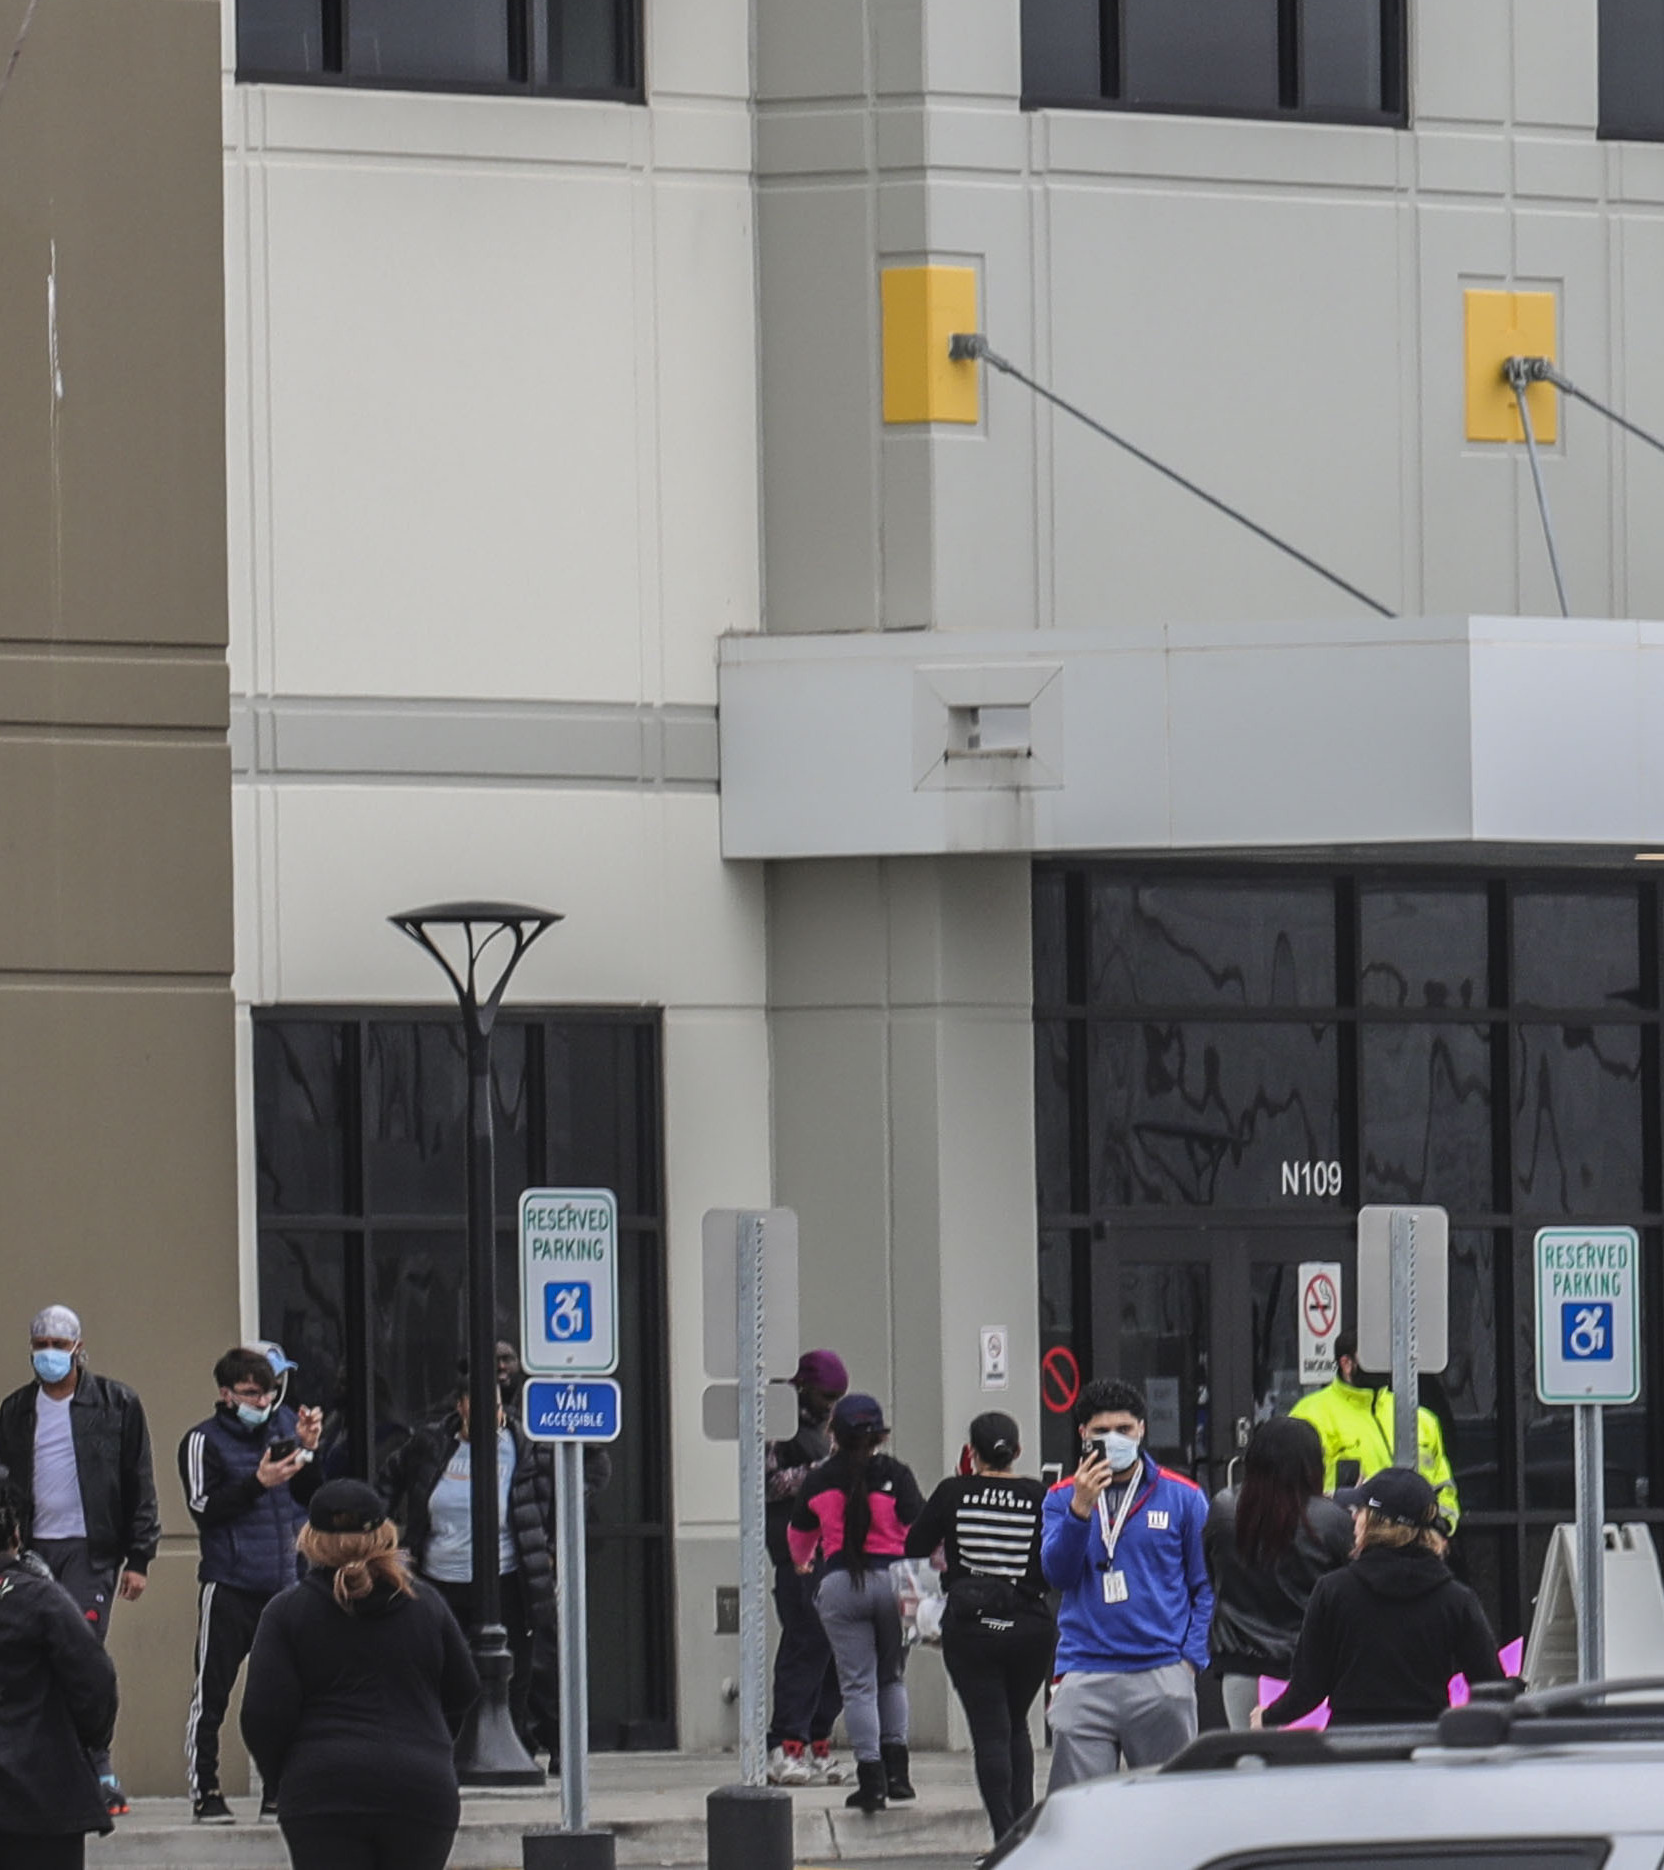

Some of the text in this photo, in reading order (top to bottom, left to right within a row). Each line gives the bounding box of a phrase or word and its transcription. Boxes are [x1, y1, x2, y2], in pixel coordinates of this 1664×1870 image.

[1282, 1160, 1342, 1196] N109
[526, 1207, 609, 1231] RESERVED
[532, 1237, 604, 1261] PARKING
[1545, 1243, 1628, 1269] RESERVED
[1553, 1272, 1622, 1297] PARKING
[555, 1391, 588, 1411] VAN
[539, 1412, 604, 1427] ACCESSIBLE
